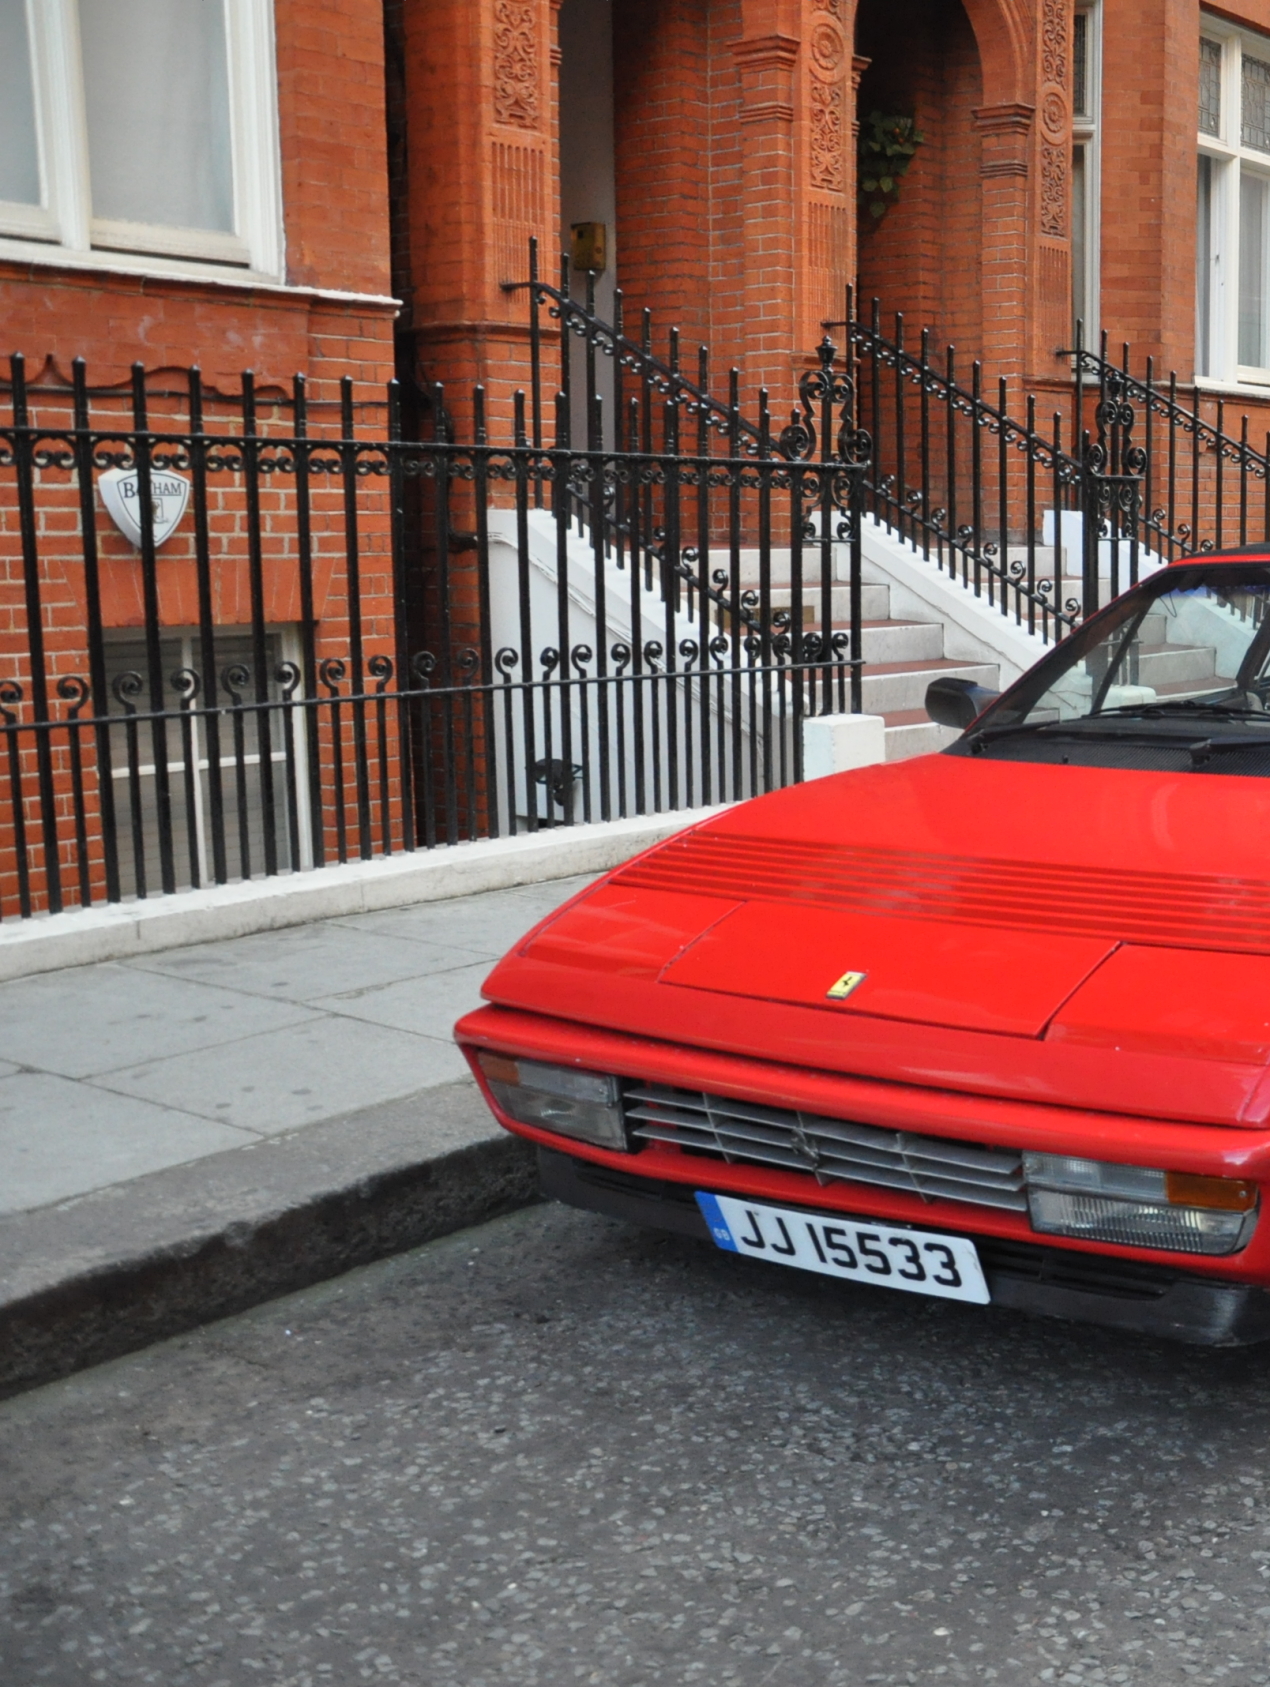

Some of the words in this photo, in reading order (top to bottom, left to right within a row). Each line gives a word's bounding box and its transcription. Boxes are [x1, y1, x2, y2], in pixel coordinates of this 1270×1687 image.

[123, 482, 182, 498] BHAM
[713, 1227, 731, 1241] GB
[741, 1210, 796, 1256] JJ
[805, 1222, 962, 1288] 15533
